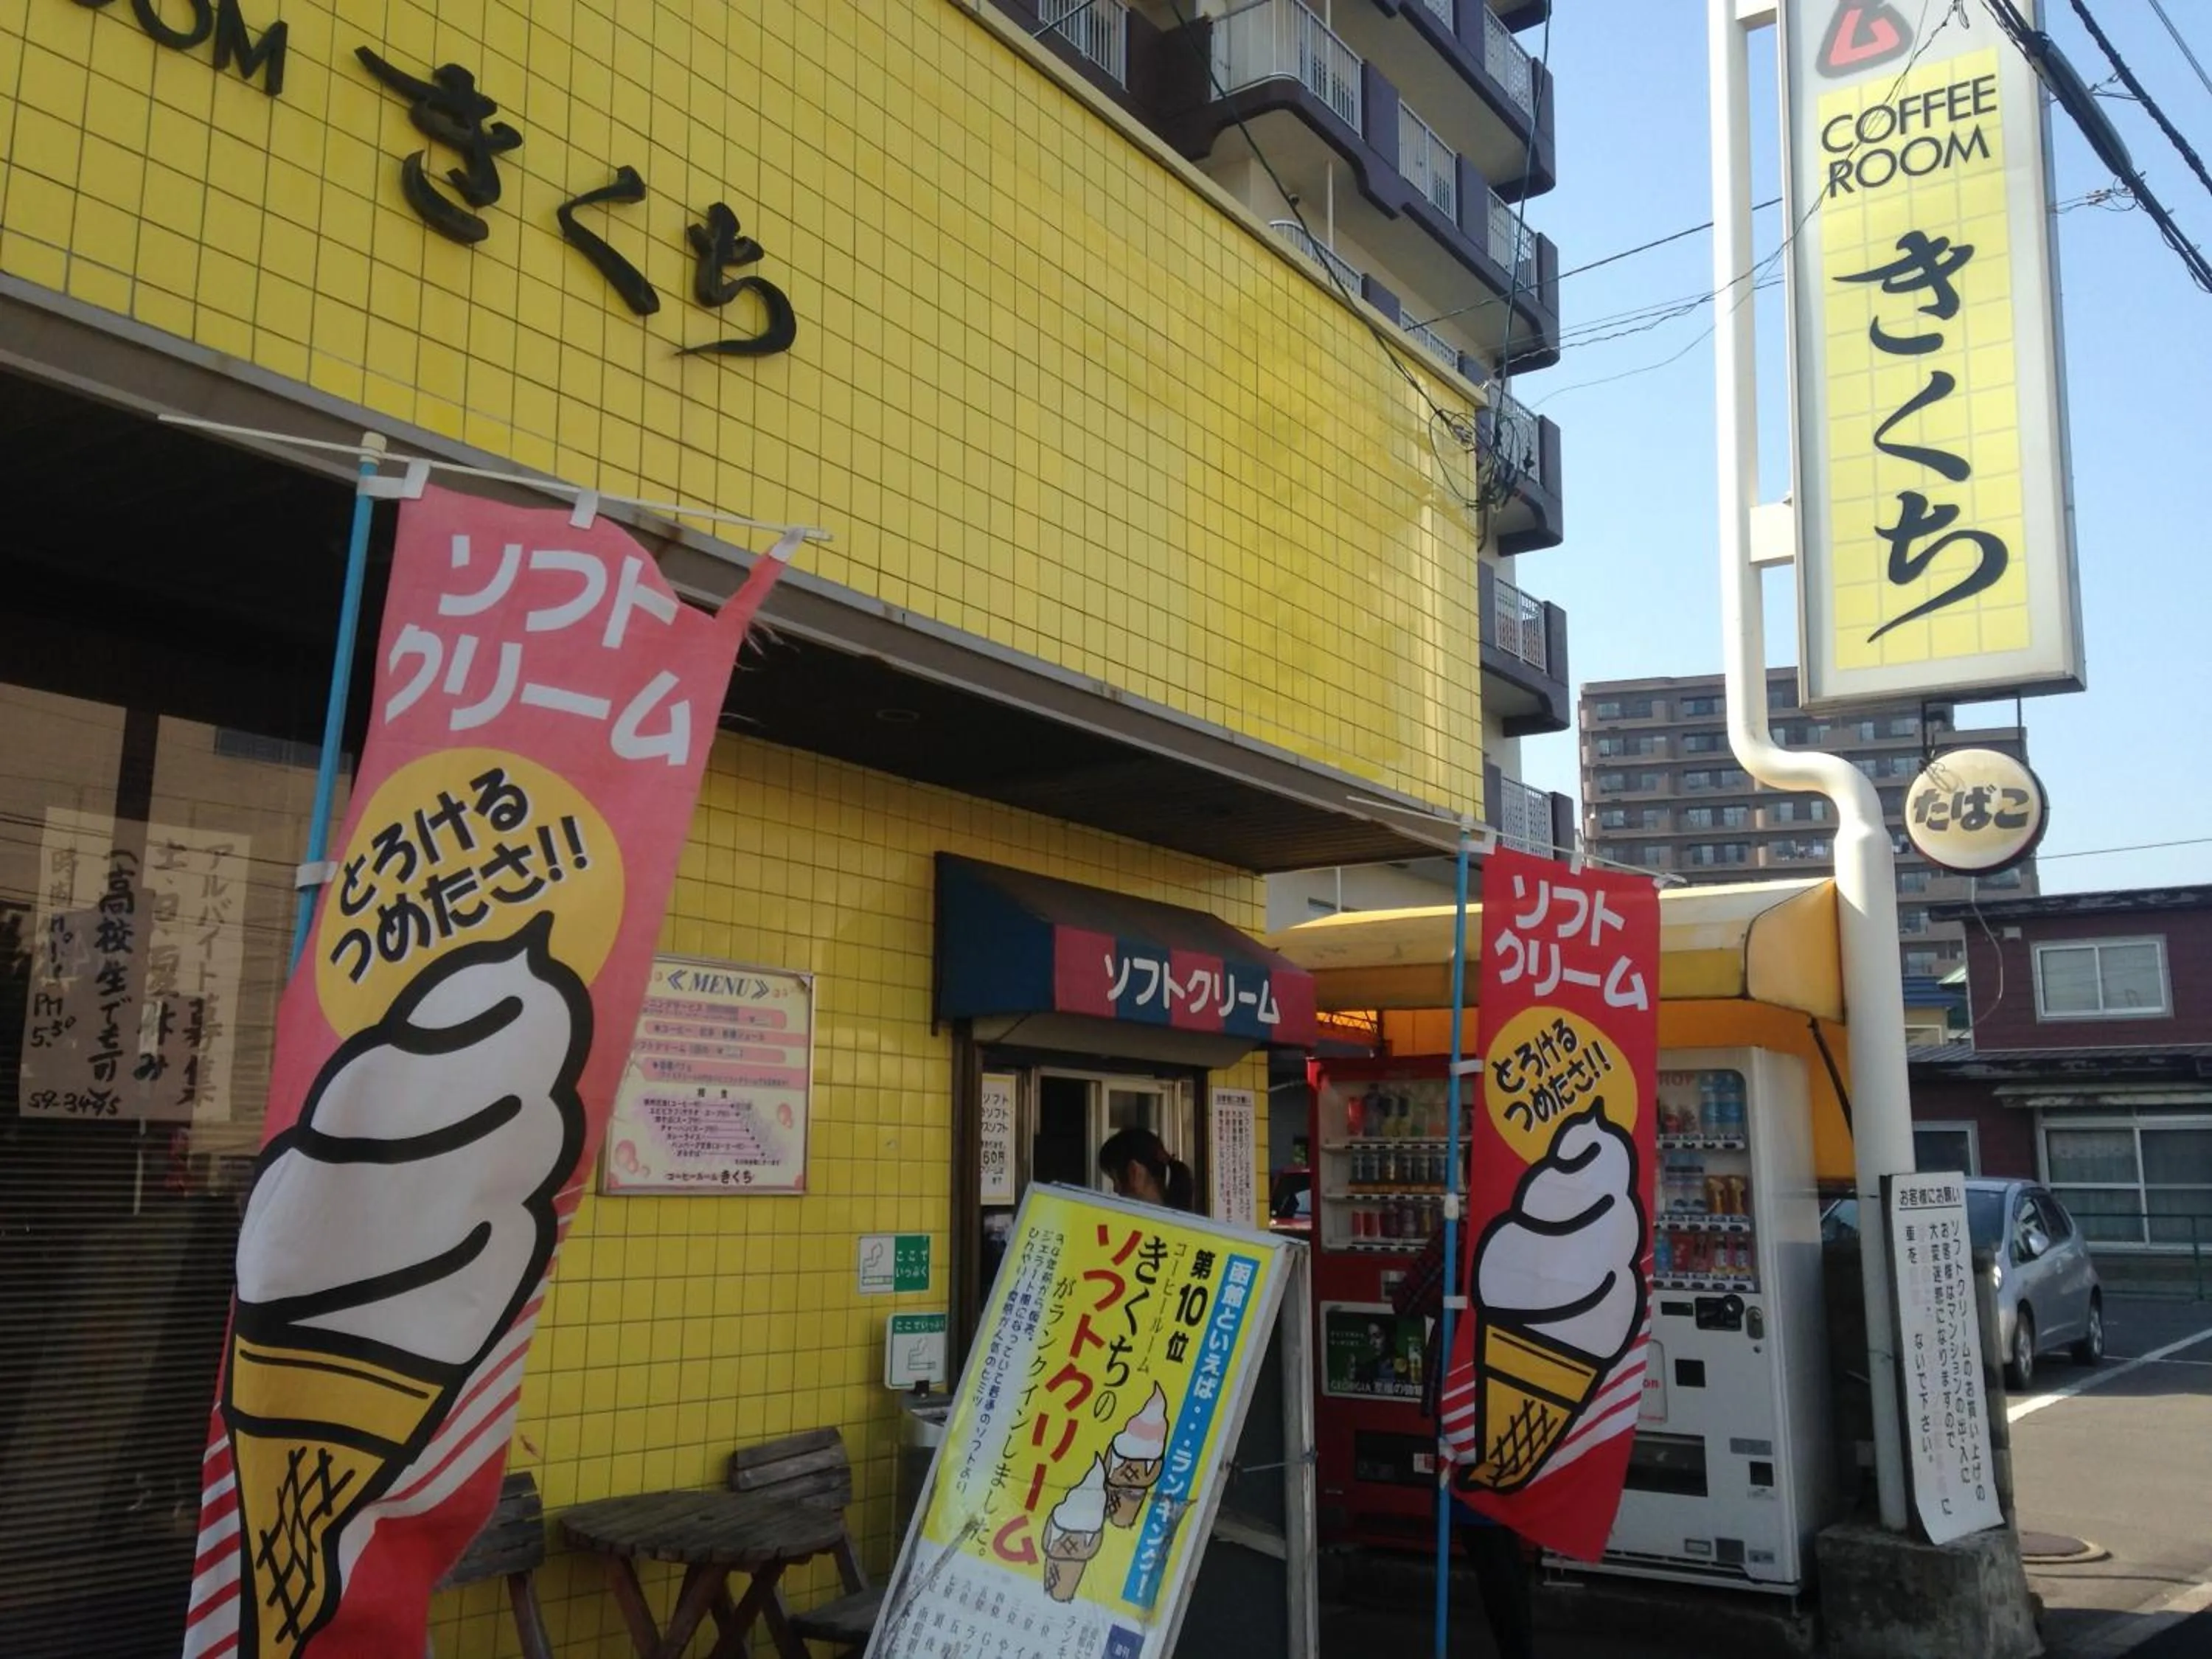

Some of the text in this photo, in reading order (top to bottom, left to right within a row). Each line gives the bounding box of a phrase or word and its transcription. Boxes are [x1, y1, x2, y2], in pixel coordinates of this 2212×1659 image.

[70, 0, 288, 96] OM
[1821, 74, 1997, 153] COFFEE
[354, 45, 797, 358] きくち
[1829, 124, 1990, 198] ROOM
[1833, 229, 2009, 643] きくち
[437, 535, 679, 648] ソフト
[385, 623, 691, 766] クリーム
[339, 768, 529, 918] とろける
[1913, 784, 2031, 833] たばこ
[1514, 875, 1626, 946] ソフト
[689, 973, 751, 996] MENU
[1104, 954, 1281, 1024] ソフトクリーム
[1495, 928, 1649, 1011] クリーム
[1491, 1018, 1579, 1094] とろける
[1899, 1186, 1961, 1206] お客様にお願い
[1166, 1249, 1216, 1363] 第10位
[992, 1224, 1142, 1565] ソフトクリーム
